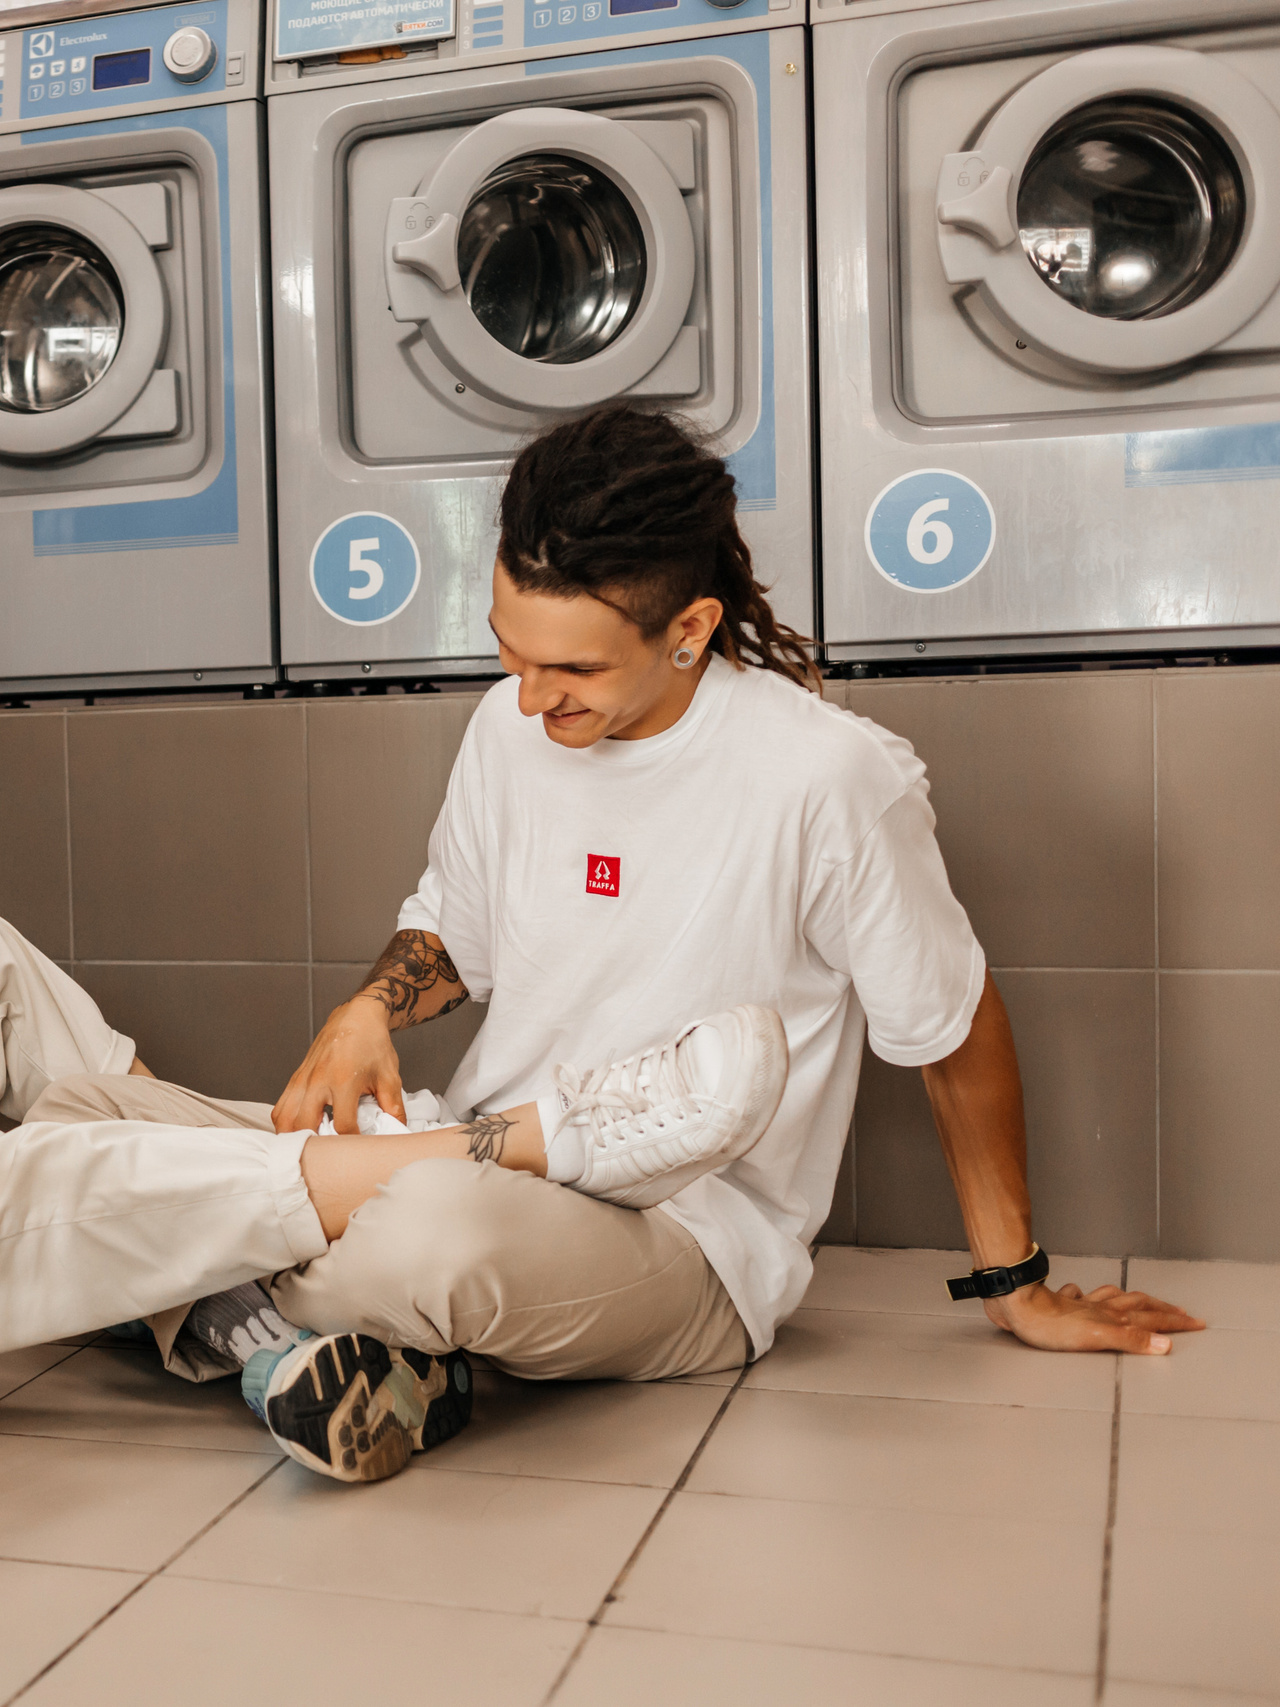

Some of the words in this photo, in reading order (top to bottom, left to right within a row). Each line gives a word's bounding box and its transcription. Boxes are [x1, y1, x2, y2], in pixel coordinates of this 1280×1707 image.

[288, 12, 348, 29] ПОДАЮТСЯ
[349, 0, 444, 20] АВТОМАТИЧЕСКИ
[539, 14, 546, 24] 1
[562, 10, 571, 22] 2
[587, 6, 596, 18] 3
[60, 33, 108, 47] Electrolux
[32, 88, 39, 98] 1
[52, 85, 60, 96] 2
[73, 81, 81, 93] 3
[906, 498, 954, 565] 6
[348, 537, 384, 600] 5
[588, 880, 615, 891] TRAFFA
